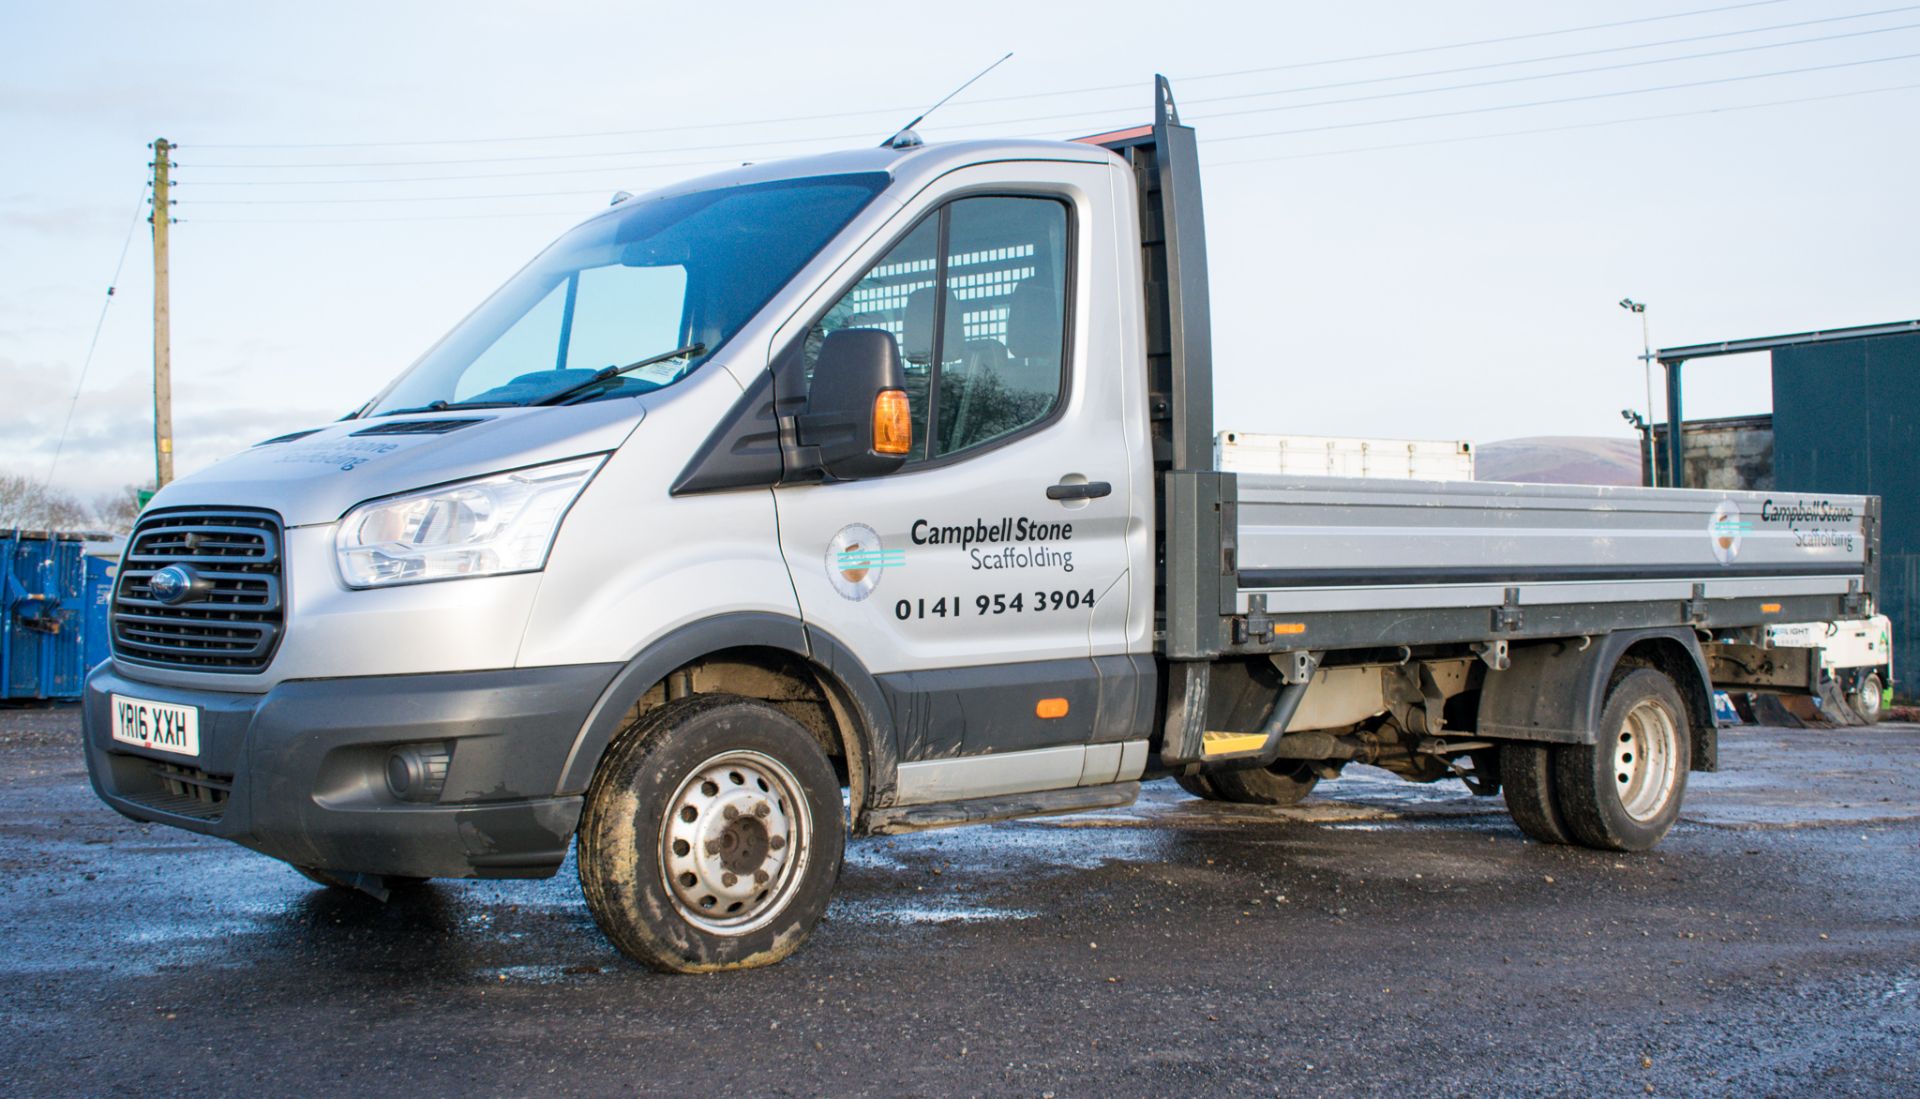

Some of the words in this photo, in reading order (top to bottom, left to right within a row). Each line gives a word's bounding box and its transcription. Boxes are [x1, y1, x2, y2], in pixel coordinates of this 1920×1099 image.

[1793, 529, 1853, 552] Scaffolding
[970, 546, 1074, 572] Scaffolding
[895, 596, 960, 620] 0141
[975, 591, 1023, 616] 954
[1034, 588, 1095, 611] 3904
[118, 701, 148, 740] YR16
[152, 708, 187, 747] XXH
